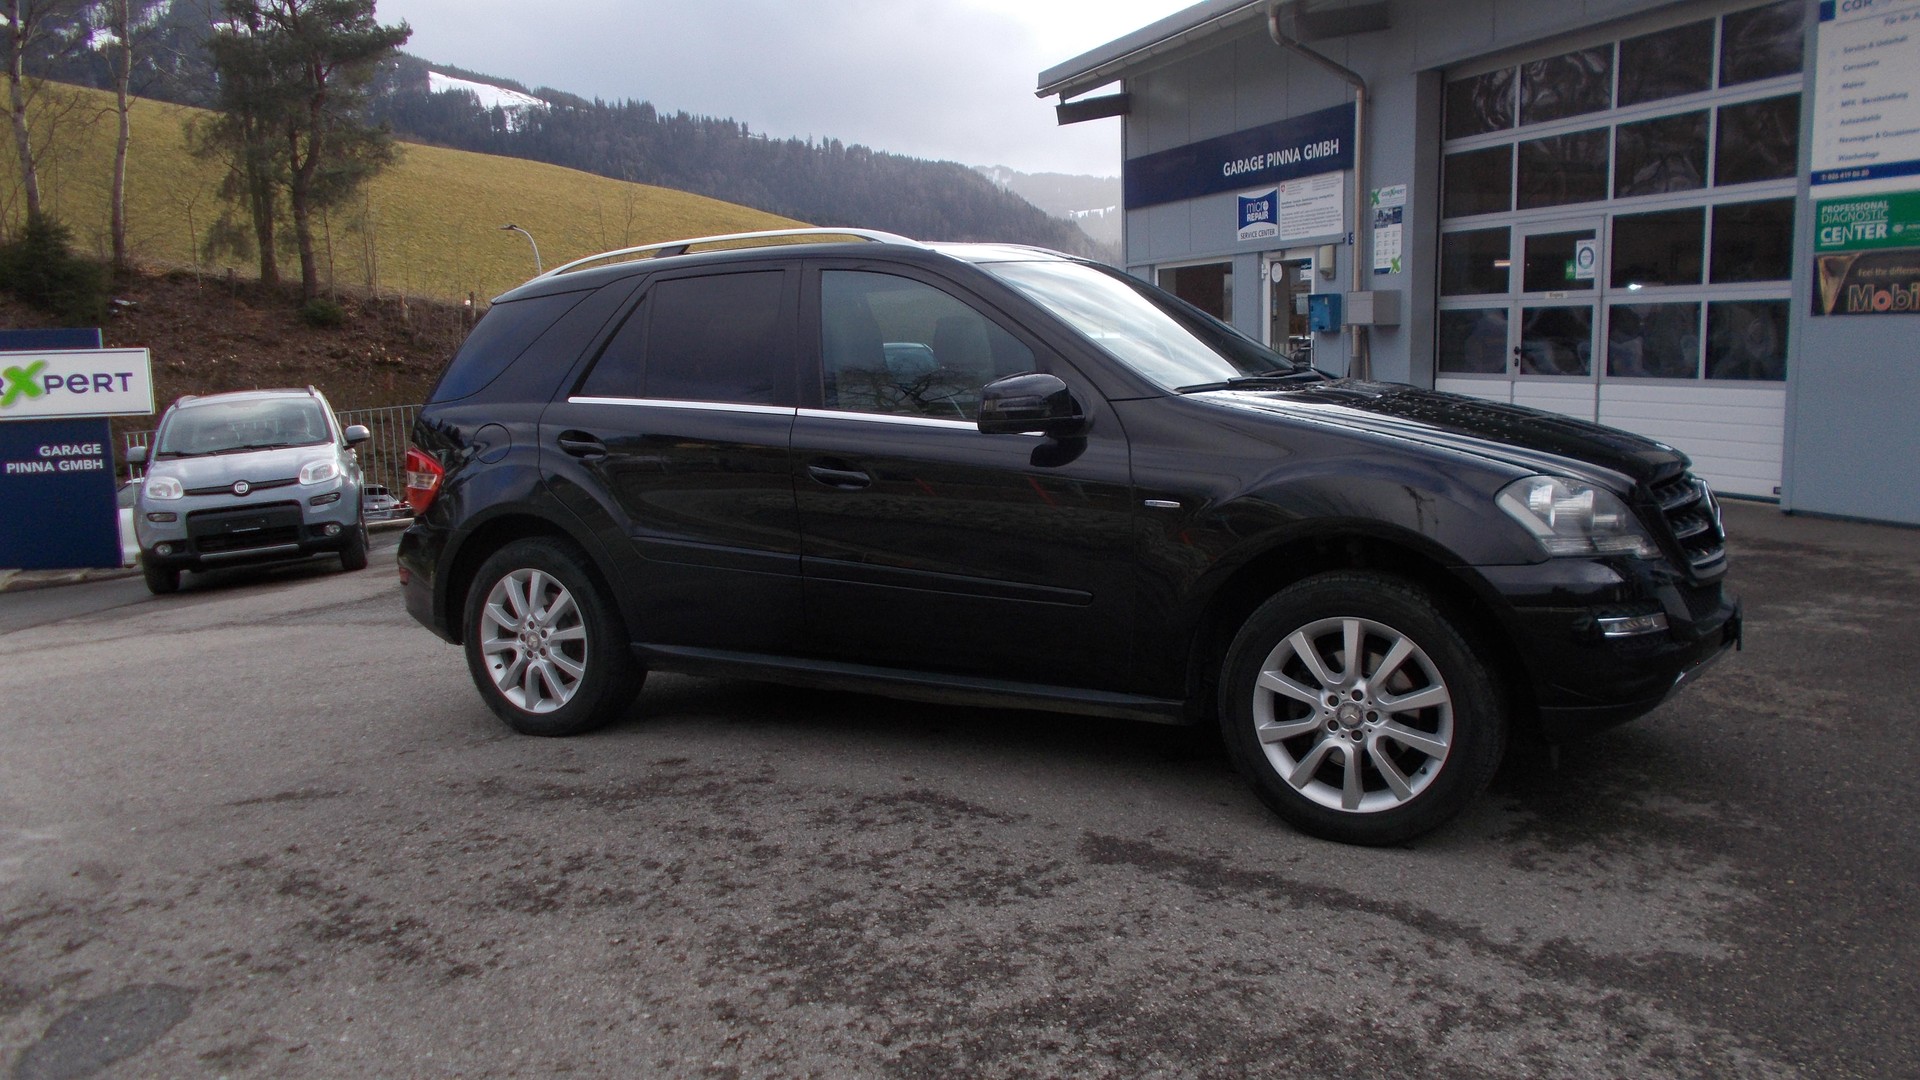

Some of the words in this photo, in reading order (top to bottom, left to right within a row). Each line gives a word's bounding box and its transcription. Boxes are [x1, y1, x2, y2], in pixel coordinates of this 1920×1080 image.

[1223, 155, 1265, 177] GARAGE
[1267, 147, 1301, 169] PINNA
[1304, 138, 1339, 160] GMBH
[1247, 199, 1269, 214] micro
[1821, 200, 1889, 214] PROFESSIONAL
[1246, 210, 1269, 222] REPAIR
[1821, 209, 1889, 225] DIAGNOSTIC
[1240, 231, 1258, 240] SERVICE
[1258, 228, 1276, 238] CENTER
[1820, 223, 1888, 243] CENTER
[1848, 282, 1920, 312] Mobi
[39, 443, 102, 457] GARAGE
[6, 460, 55, 474] PINNA
[58, 458, 104, 472] GMBH
